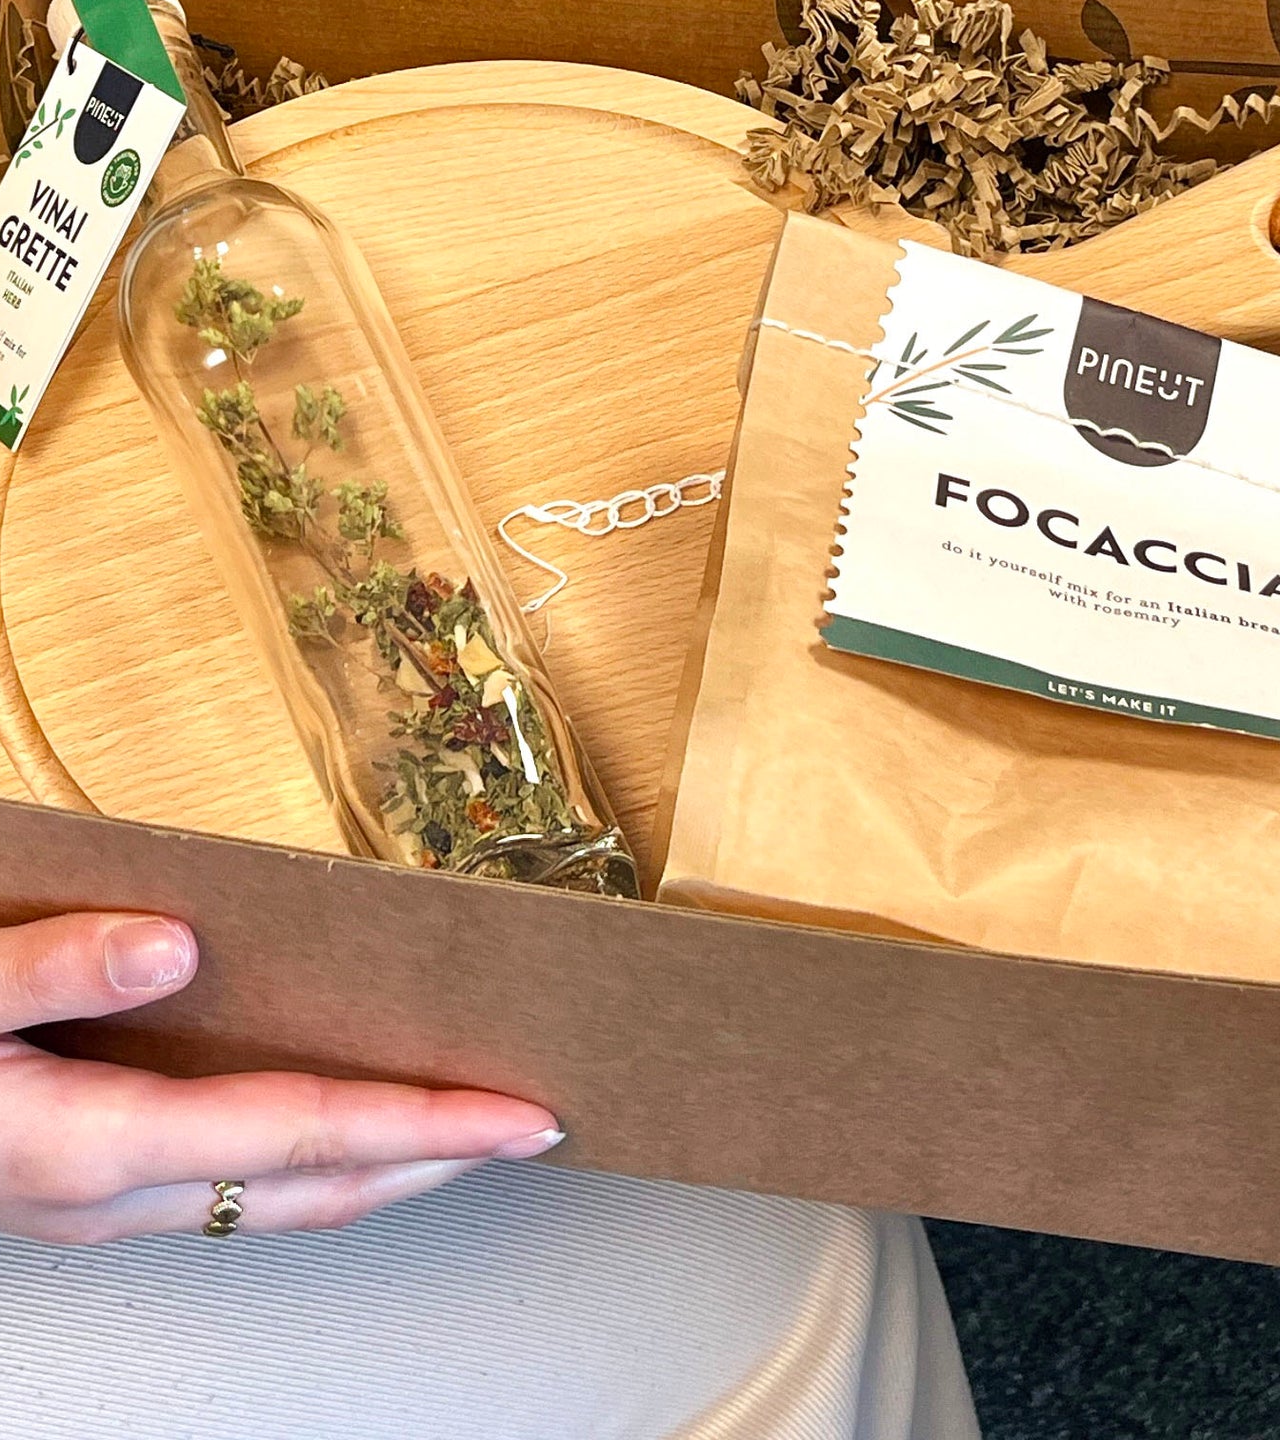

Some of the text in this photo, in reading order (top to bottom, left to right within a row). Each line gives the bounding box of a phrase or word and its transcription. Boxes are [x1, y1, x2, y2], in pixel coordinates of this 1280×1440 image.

[85, 96, 125, 131] PINEUT
[29, 179, 88, 243] VINAI
[2, 288, 22, 309] HERB
[6, 270, 34, 296] ITALIAN
[1076, 346, 1205, 407] PINEUT
[941, 541, 963, 554] do
[969, 548, 982, 561] it
[989, 555, 1063, 586] yourself
[1067, 581, 1098, 597] mix
[1106, 591, 1132, 605] for
[1139, 599, 1160, 610] an
[1168, 602, 1231, 624] Italian
[1048, 588, 1181, 628] with rosemary
[1047, 680, 1177, 716] LET'S MAKE IT
